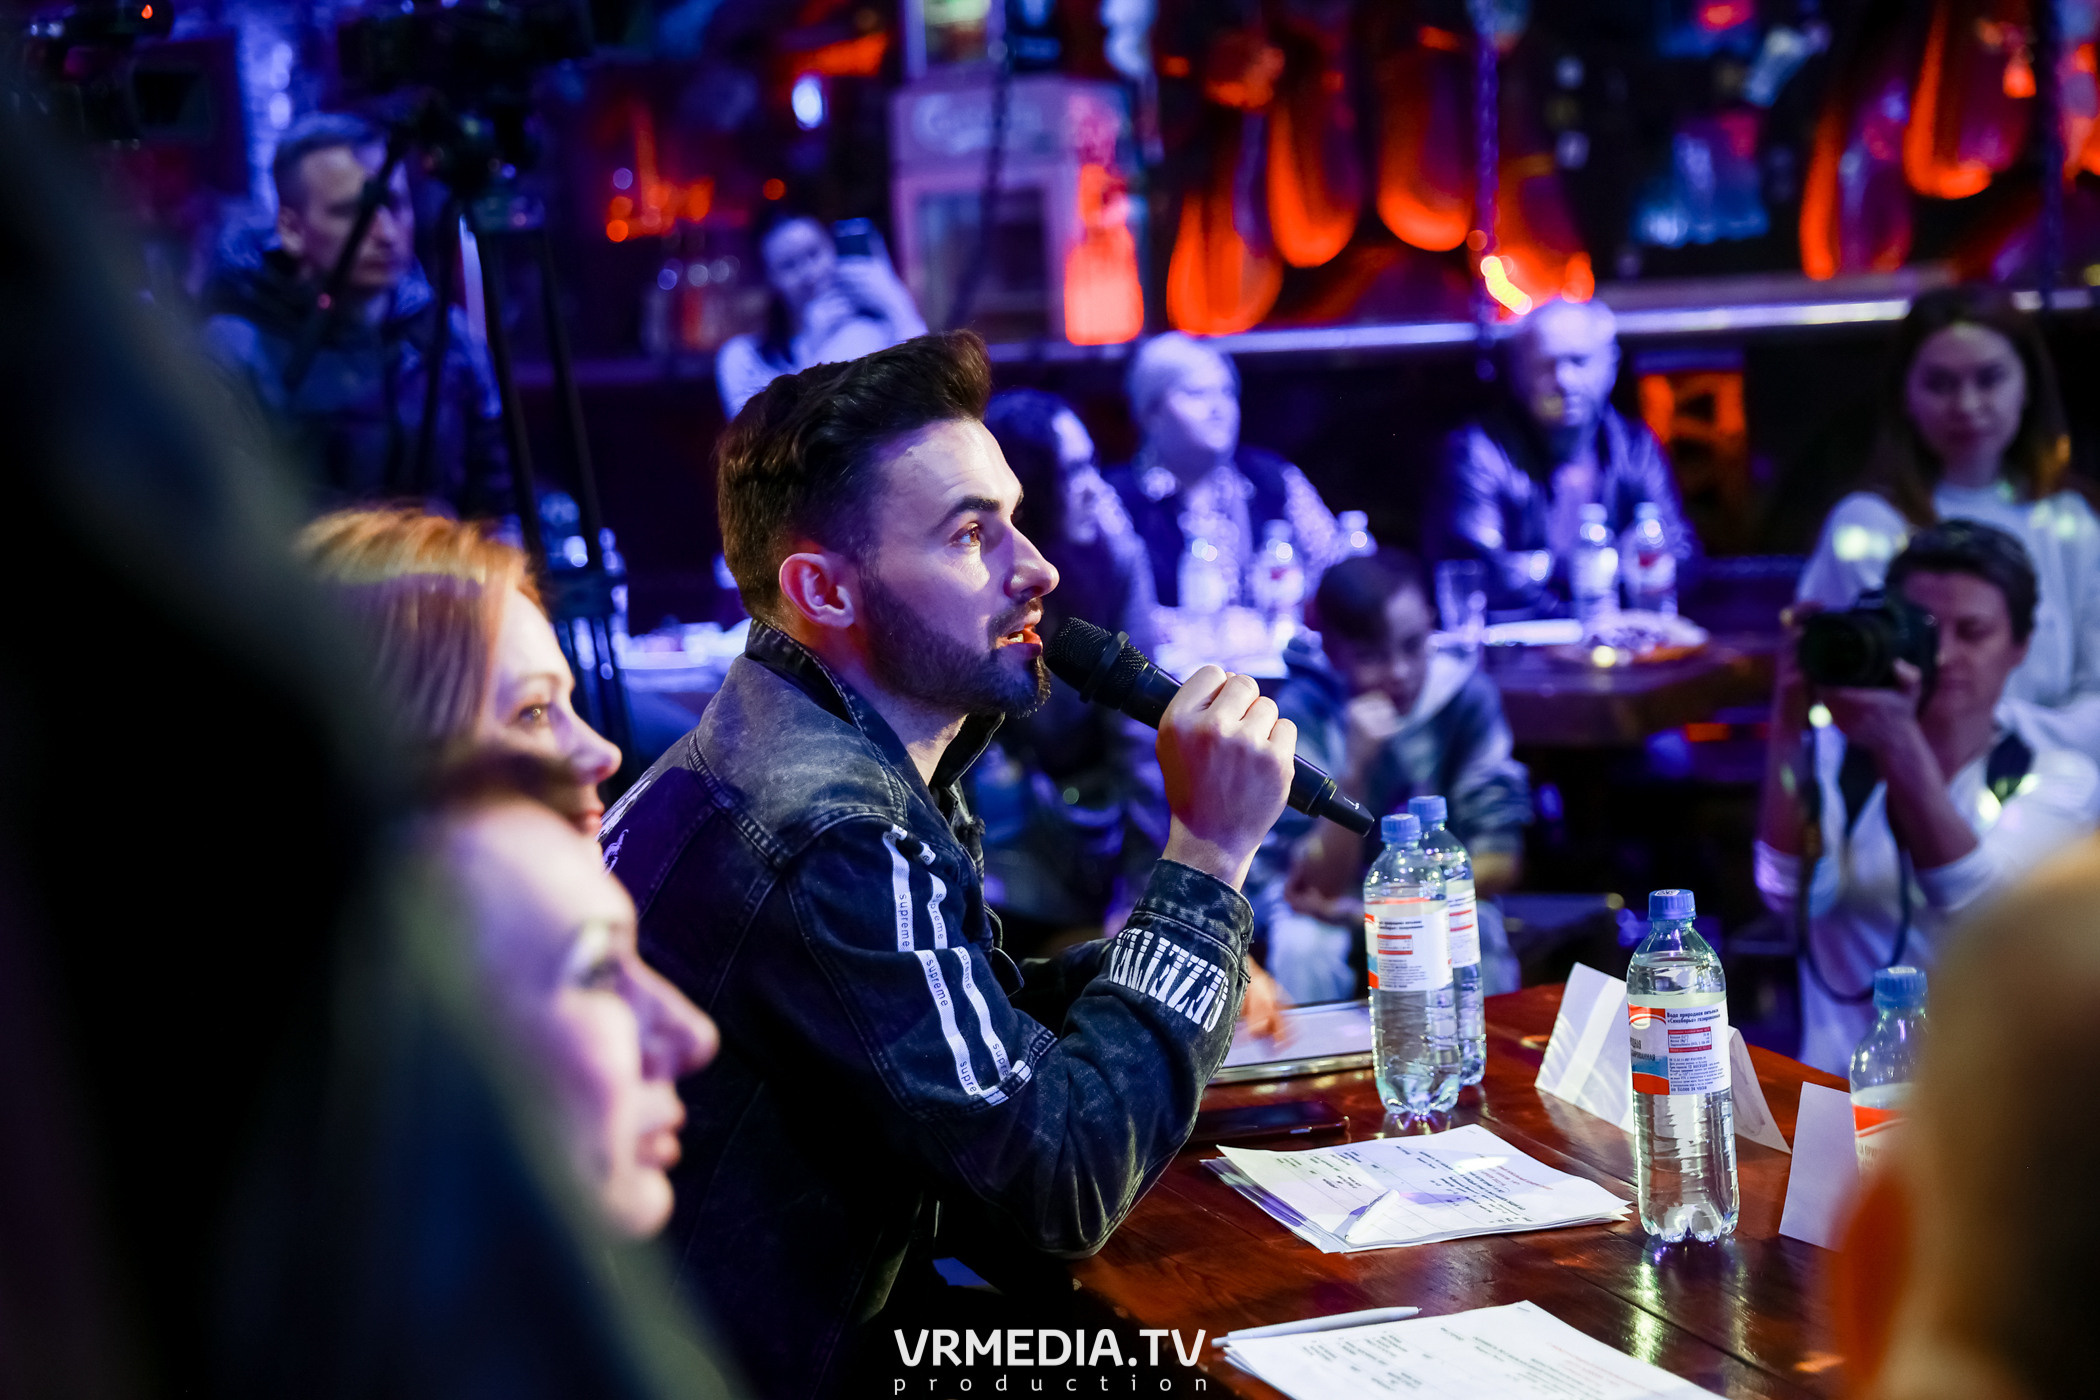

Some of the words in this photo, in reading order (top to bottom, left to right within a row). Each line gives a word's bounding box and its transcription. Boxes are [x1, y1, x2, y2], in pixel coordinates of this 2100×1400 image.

[898, 893, 911, 948] supreme
[928, 893, 944, 940] spreme
[926, 958, 949, 1007] supreme
[957, 948, 972, 989] upreme
[960, 1061, 977, 1093] supre
[993, 1043, 1009, 1076] supre
